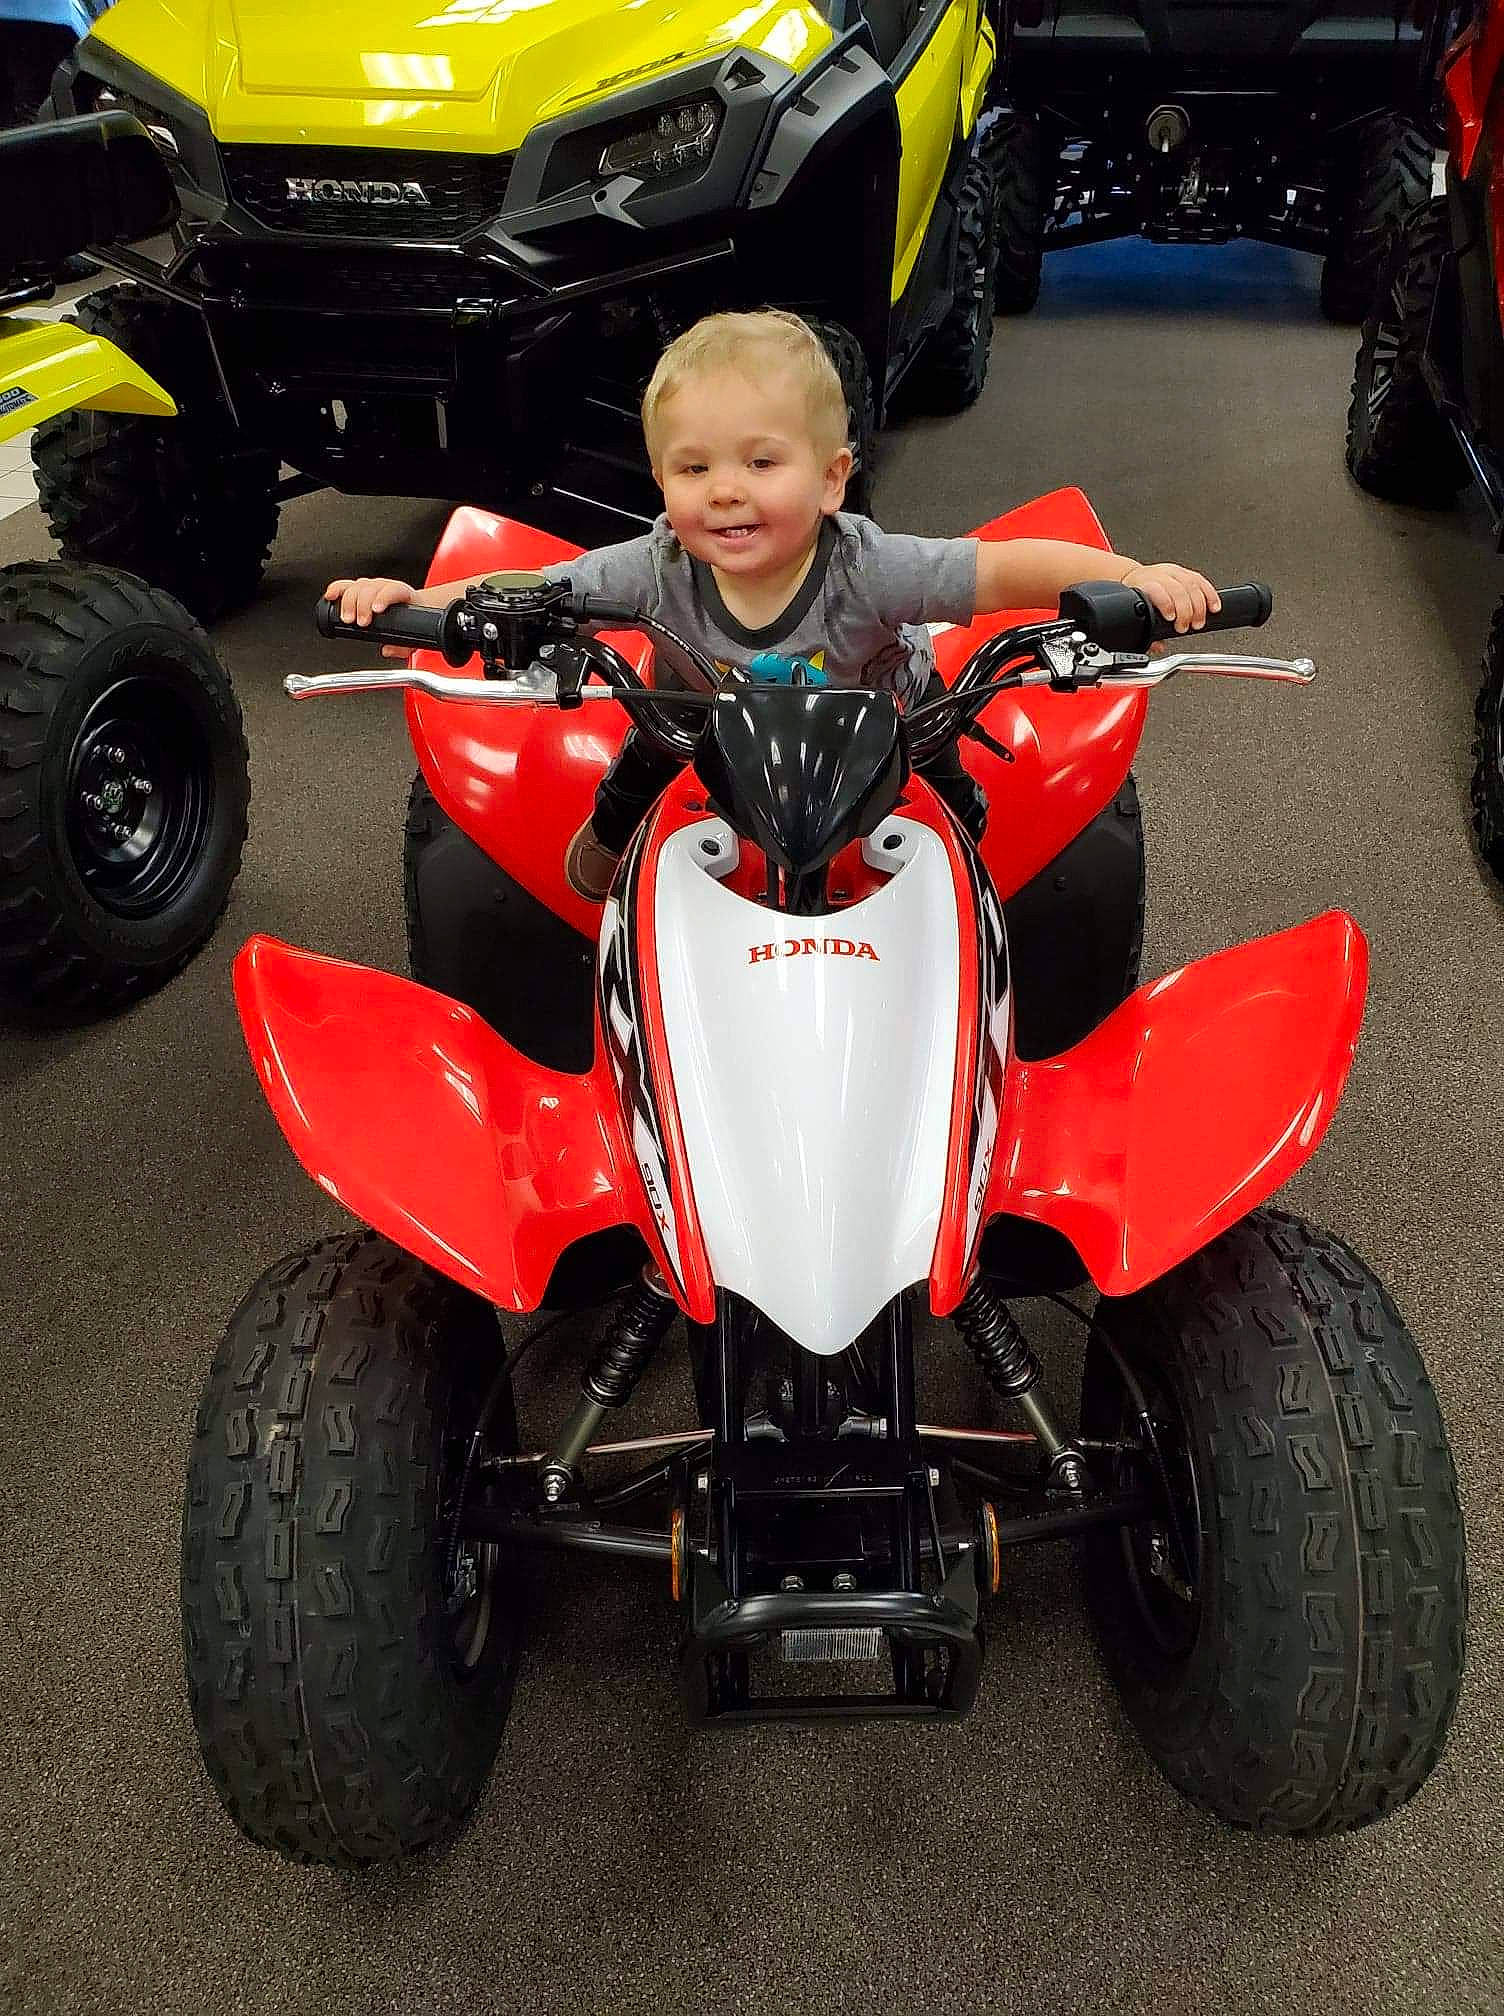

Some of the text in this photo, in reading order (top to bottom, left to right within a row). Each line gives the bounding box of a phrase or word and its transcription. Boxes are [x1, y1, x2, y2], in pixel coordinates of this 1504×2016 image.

[286, 178, 431, 206] HONDA
[749, 938, 881, 964] HONDA
[641, 1162, 673, 1233] 90X
